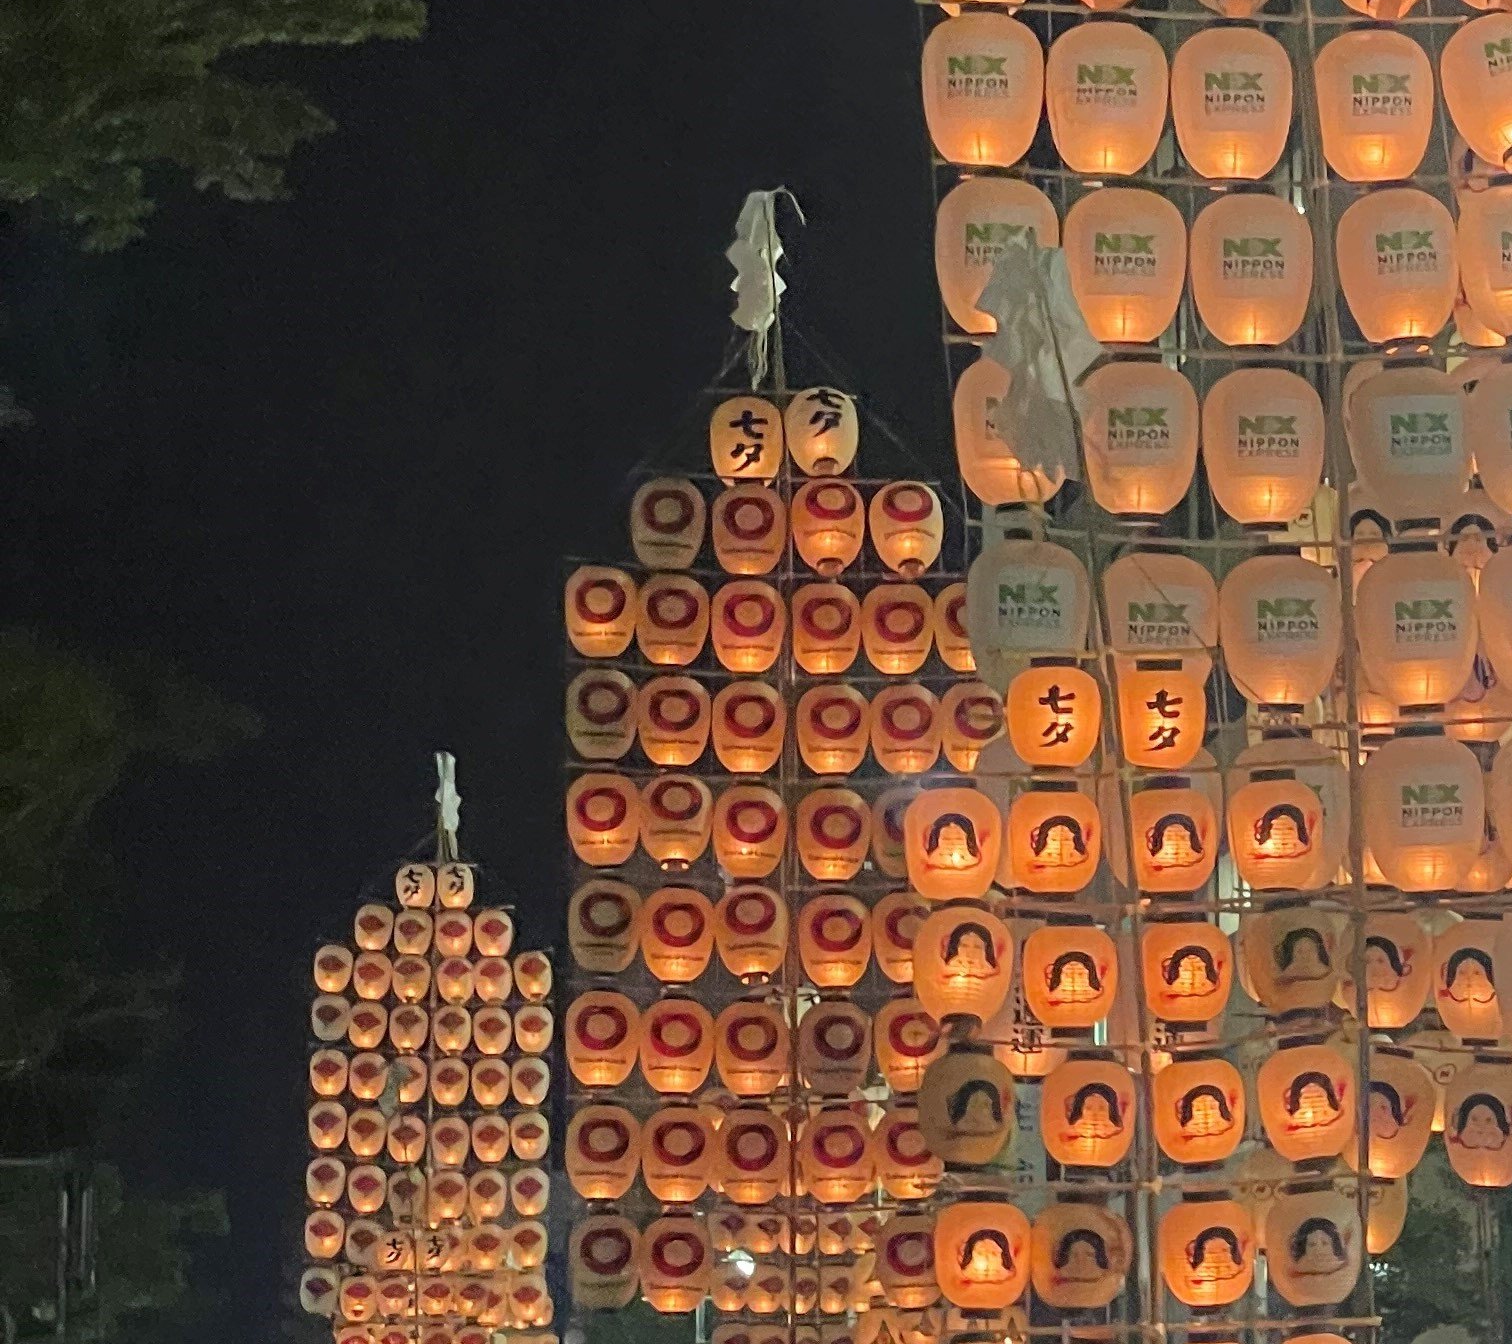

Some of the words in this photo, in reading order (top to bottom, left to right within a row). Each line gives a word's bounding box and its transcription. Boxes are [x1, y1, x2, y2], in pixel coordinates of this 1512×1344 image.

[947, 56, 1006, 75] NX
[1078, 64, 1138, 84] NX
[948, 77, 1008, 89] NIPPON
[1205, 73, 1262, 91] NX
[1353, 75, 1411, 93] NX
[1205, 93, 1264, 103] NIPPON
[1353, 96, 1412, 106] NIPPON
[1095, 232, 1157, 254] NX
[1223, 238, 1282, 256] NX
[1375, 231, 1434, 252] NX
[966, 247, 1004, 256] NIPP
[1377, 252, 1437, 264] NIPPON
[1095, 256, 1156, 266] NIPPON
[1223, 259, 1284, 270] NIPPON
[806, 389, 845, 437] 七夕
[1108, 407, 1168, 426] NX
[1239, 416, 1297, 434] NX
[1391, 413, 1449, 432] NX
[729, 410, 768, 472] 七夕
[1108, 429, 1170, 440] NIPPON
[1239, 438, 1298, 448] NIPPON
[1000, 583, 1057, 603] NX
[1129, 602, 1190, 622] NX
[1257, 598, 1316, 618] NX
[1395, 600, 1452, 618] NX
[1129, 624, 1190, 636] NIPPON
[1258, 619, 1319, 630] NIPPON
[1396, 622, 1456, 633] NIPPON
[1039, 684, 1076, 747] 七夕
[1144, 688, 1183, 752] 七夕
[1402, 784, 1461, 805] NX
[1402, 807, 1462, 816] NIPPON
